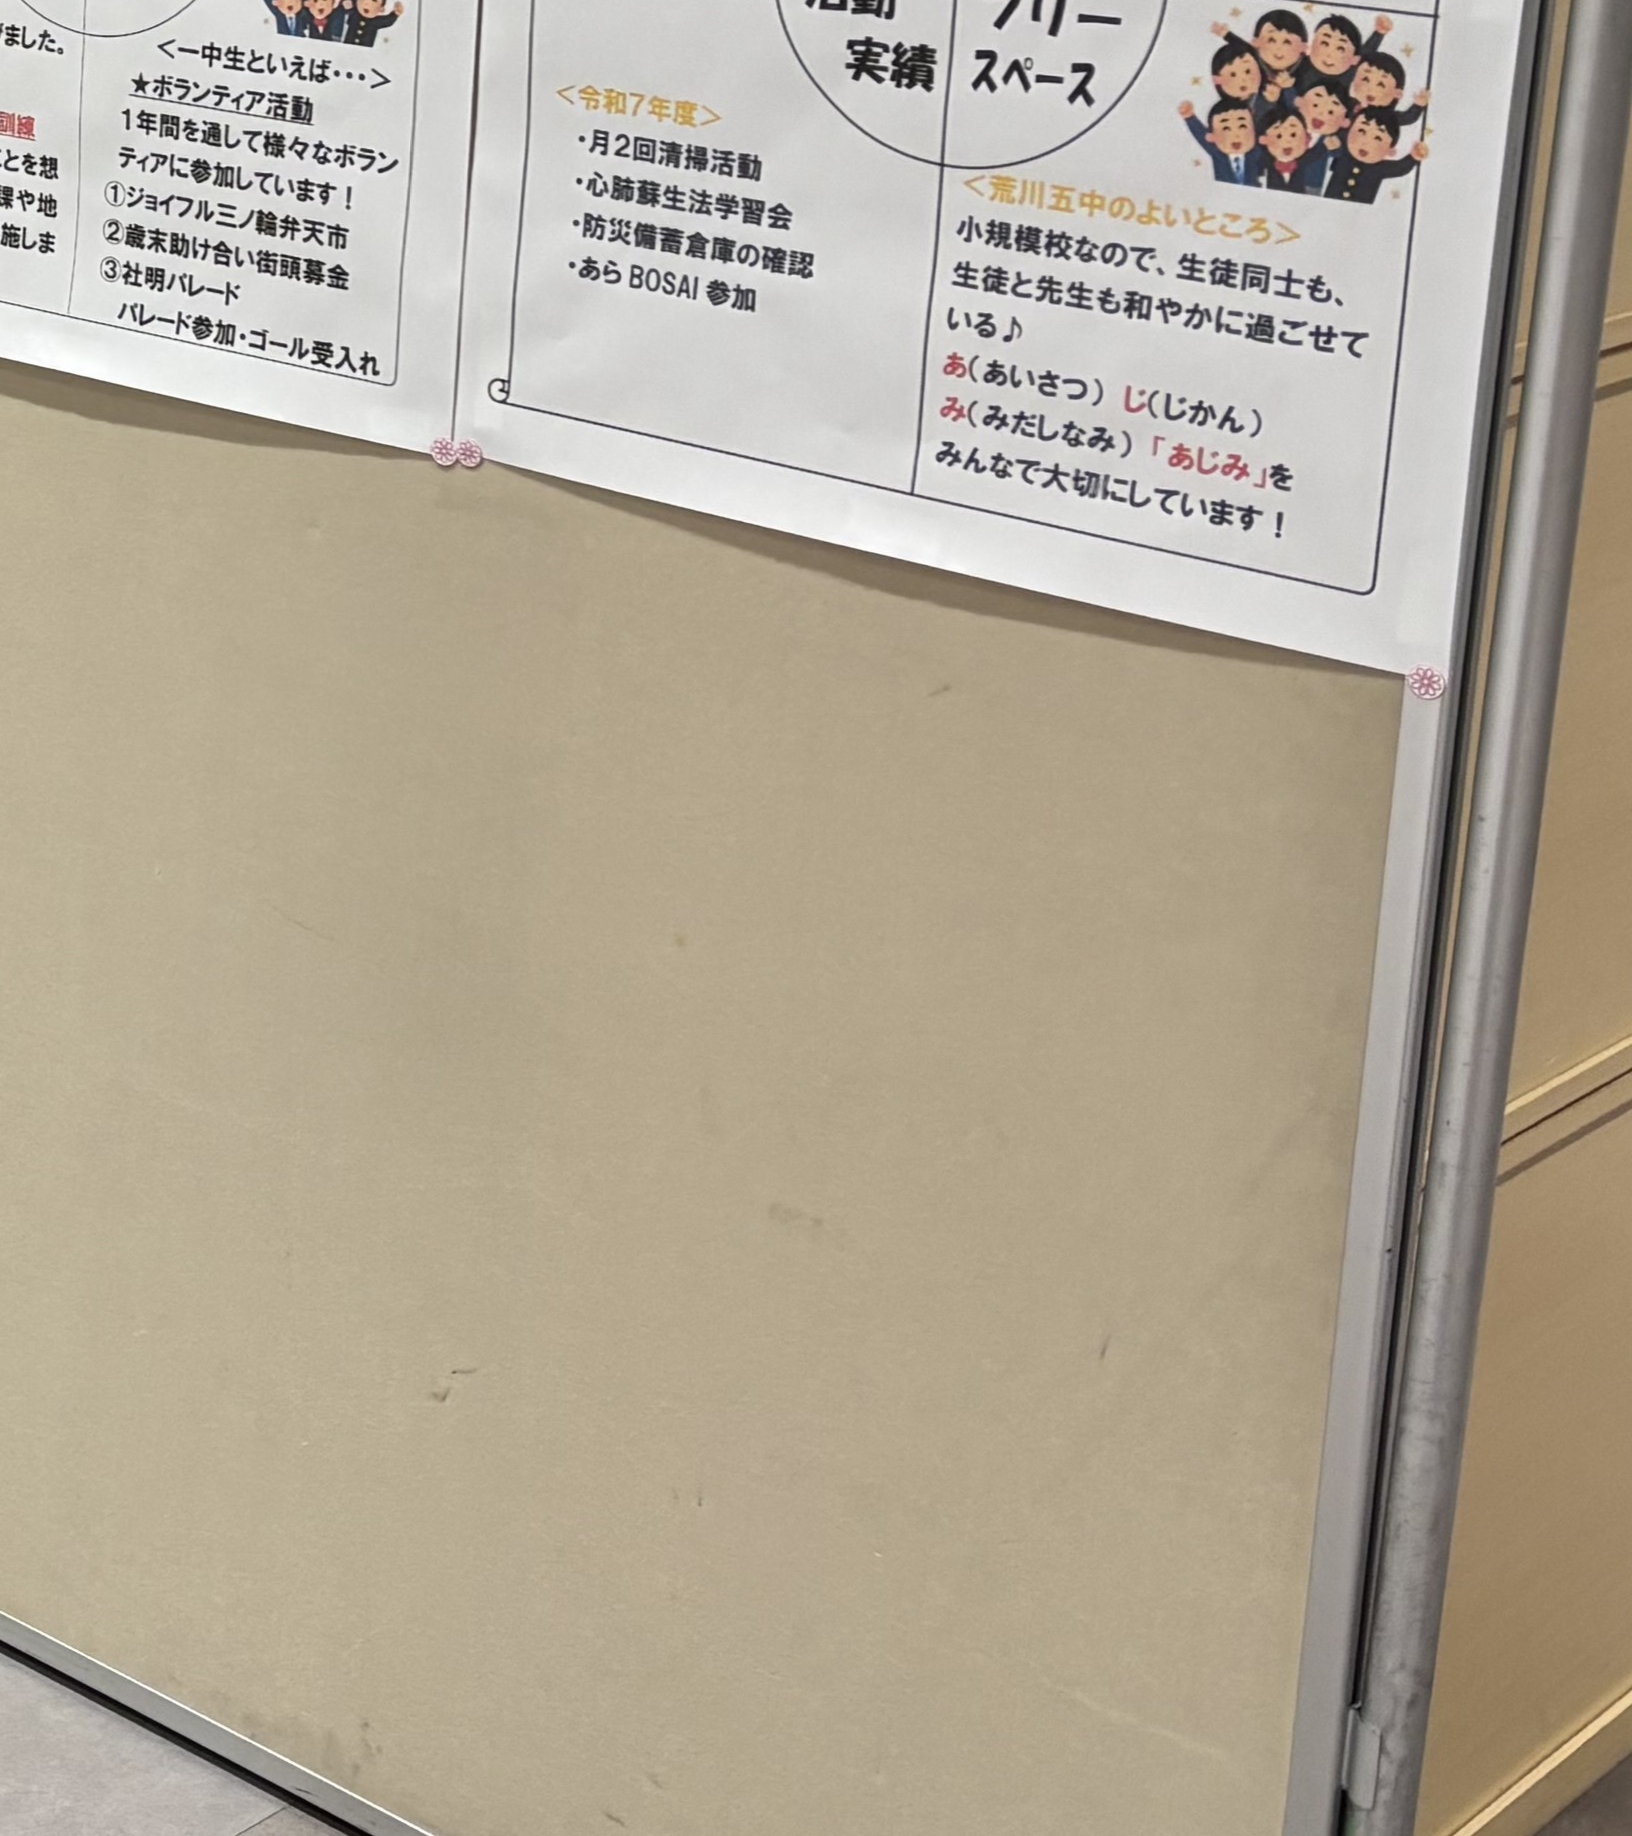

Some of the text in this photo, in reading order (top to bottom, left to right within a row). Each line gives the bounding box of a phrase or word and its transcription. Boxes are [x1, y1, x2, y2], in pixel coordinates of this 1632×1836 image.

[844, 35, 939, 93] 実績
[971, 49, 1097, 108] スペース
[628, 264, 700, 303] BOSAI
[705, 277, 758, 314] 参加
[935, 440, 1288, 539] みんなで大切にしています！
